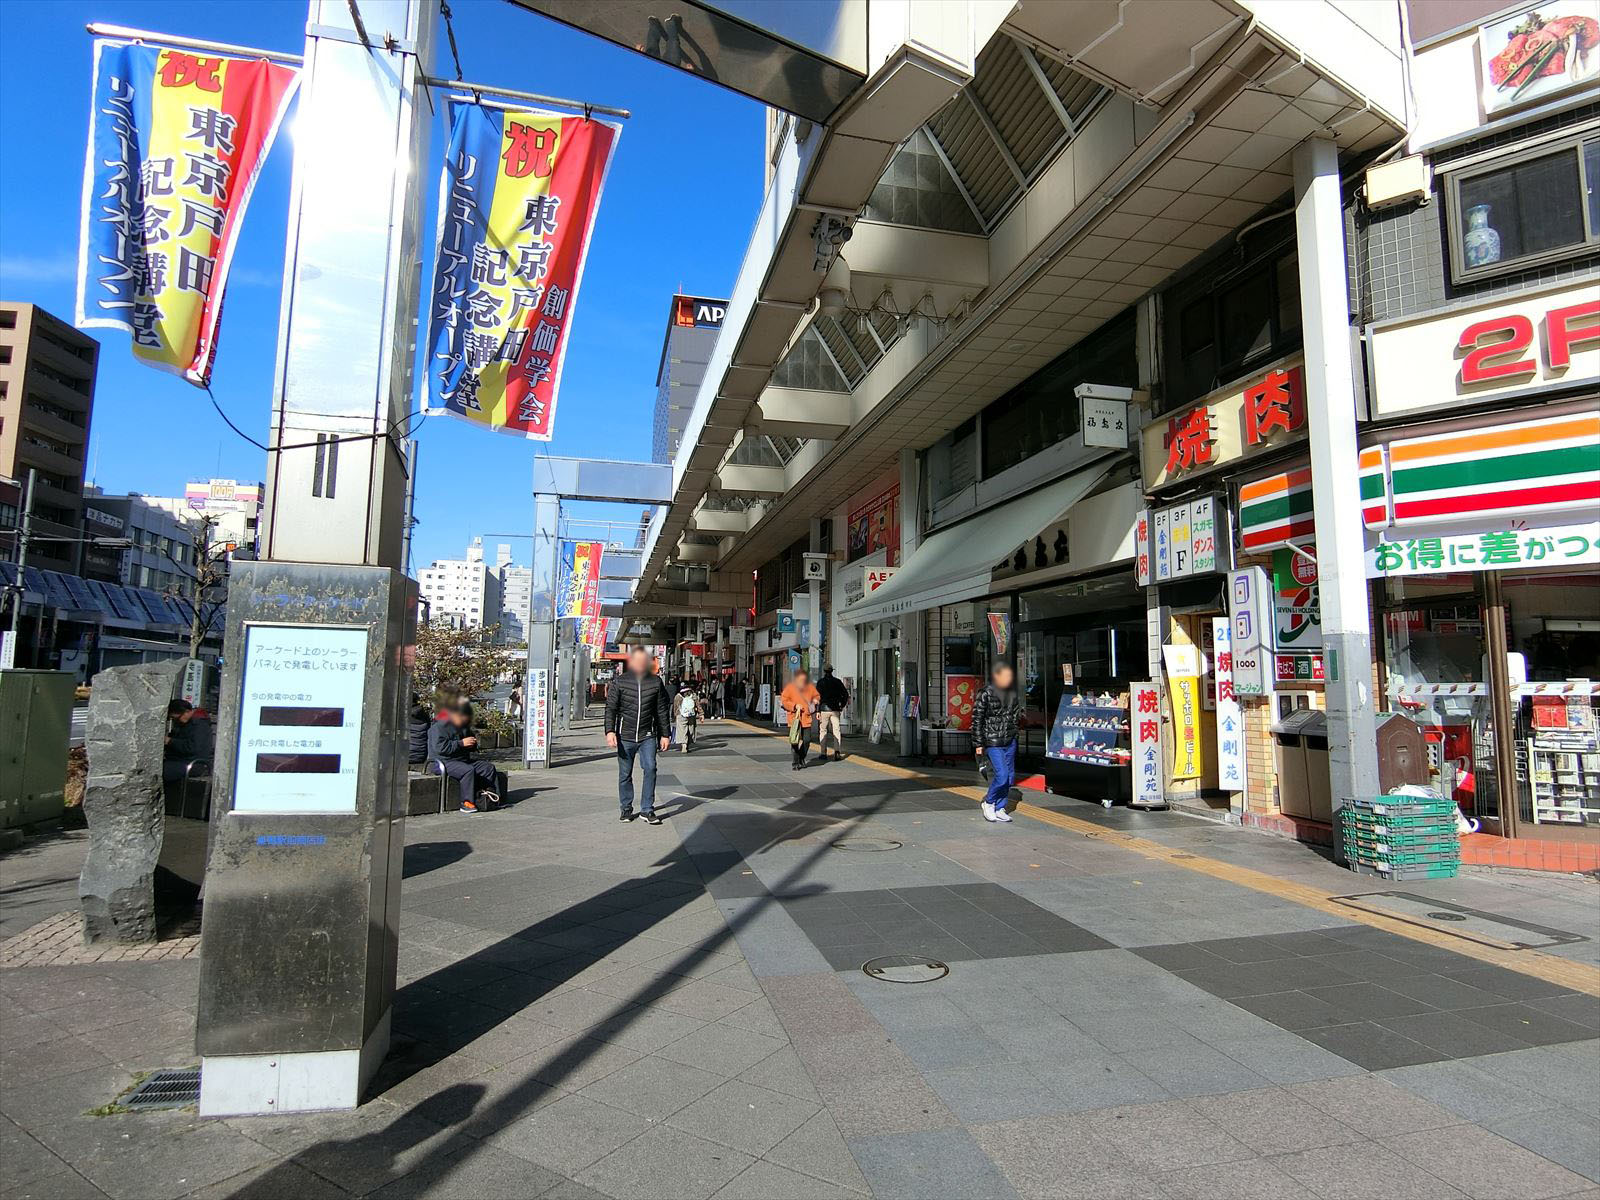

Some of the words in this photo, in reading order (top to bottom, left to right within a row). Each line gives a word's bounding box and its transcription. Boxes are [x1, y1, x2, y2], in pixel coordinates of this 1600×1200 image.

[158, 51, 223, 93] 祝
[503, 121, 557, 179] 祝
[178, 107, 238, 302] 東京戸田
[436, 149, 478, 402] リニューアルオープン
[497, 195, 562, 366] 東京戸田
[455, 241, 509, 413] 記念講堂
[696, 305, 725, 323] AP
[518, 283, 569, 426] 創価学会
[1162, 367, 1305, 474] 焼肉
[1156, 515, 1166, 526] 2F
[1174, 510, 1185, 521] 3F
[1196, 503, 1208, 514] 4F
[1193, 519, 1213, 533] スガモ
[1136, 519, 1149, 577] 焼肉
[1193, 537, 1214, 554] ダンス
[1374, 532, 1600, 571] お得に差がつ
[1194, 557, 1215, 569] スタジオ
[253, 659, 359, 671] パネルで発電しています
[256, 644, 357, 658] アーケード上のソーラー
[1235, 660, 1256, 668] 1000
[1277, 662, 1295, 675] たばこ
[1297, 661, 1309, 674] 酒
[1235, 683, 1263, 692] マージャン
[1137, 689, 1159, 743] 焼肉
[1221, 715, 1239, 781] 金剛苑
[1144, 746, 1158, 792] 金剛苑
